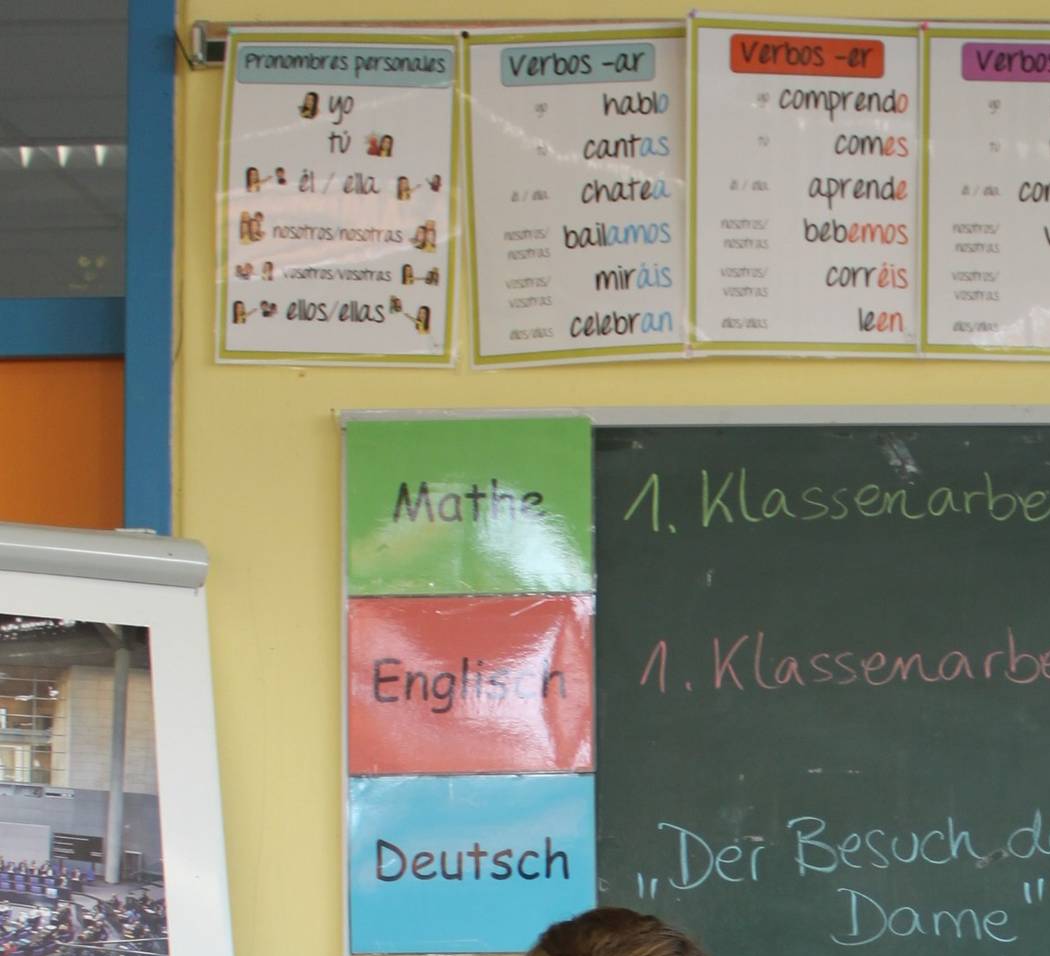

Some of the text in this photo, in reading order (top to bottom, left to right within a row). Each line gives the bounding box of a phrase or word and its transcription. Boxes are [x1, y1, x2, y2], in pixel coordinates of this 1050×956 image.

[245, 53, 446, 78] Pronombres personales
[509, 52, 645, 77] Verbos -ar
[740, 41, 874, 69] Verbos -er
[328, 96, 354, 125] yo
[603, 91, 670, 116] hablo
[779, 88, 909, 121] comprendo
[328, 130, 351, 153] tú
[583, 134, 670, 160] cantas
[834, 133, 909, 158] comes
[343, 173, 380, 194] ella
[581, 179, 672, 204] chatea
[808, 176, 908, 210] aprende
[563, 222, 673, 250] bailamos
[803, 217, 909, 245] bebemos
[595, 262, 673, 291] miráis
[826, 262, 909, 289] corréis
[286, 300, 386, 323] ellos/ellas
[570, 311, 673, 338] celebran
[858, 307, 904, 332] leen
[393, 478, 546, 523] Mathe
[623, 472, 676, 533] 1.
[639, 639, 692, 693] 1.
[373, 656, 567, 714] Englisch
[376, 836, 570, 882] Deutsch
[787, 815, 988, 877] Besuch
